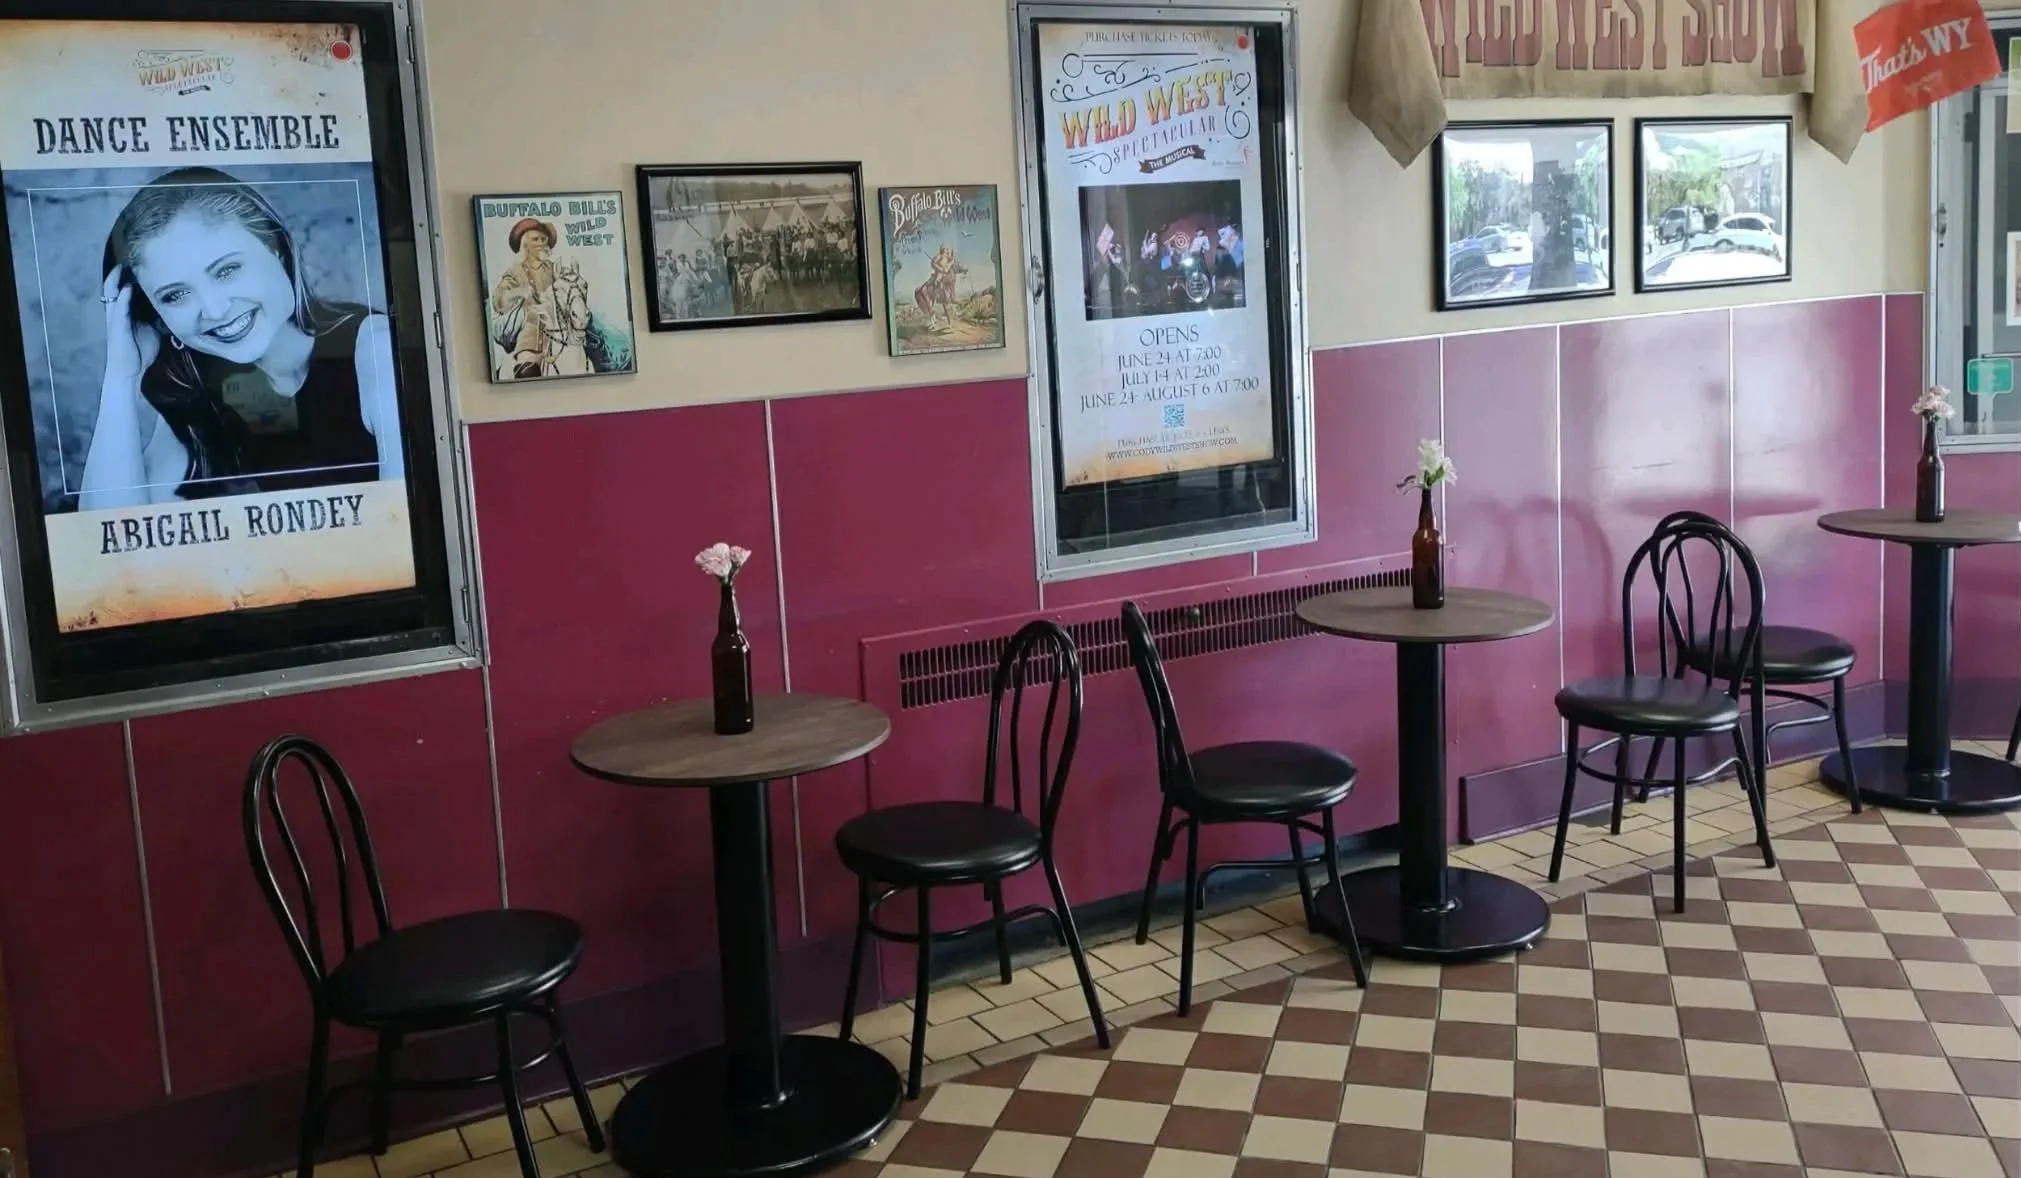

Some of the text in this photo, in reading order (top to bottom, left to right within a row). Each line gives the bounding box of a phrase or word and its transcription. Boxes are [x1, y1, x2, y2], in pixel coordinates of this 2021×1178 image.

[1085, 31, 1137, 43] PURCHASE
[1139, 31, 1178, 43] TICKETS
[1860, 37, 1927, 94] That's
[1920, 17, 1973, 56] WY
[140, 66, 177, 86] WILD
[181, 56, 224, 78] WEST
[1059, 70, 1233, 149] WILD WEST
[33, 113, 341, 155] DANCE ENSEMBLE
[1113, 115, 1217, 164] SPECTACULAR
[1149, 160, 1163, 170] THE
[1164, 147, 1196, 164] MUSICAL
[483, 199, 617, 218] BUFFALO BILL'S
[888, 192, 932, 239] Buffalo
[932, 189, 961, 210] Bill's
[565, 217, 608, 235] WILD
[566, 233, 615, 247] WEST
[1139, 324, 1200, 347] OPENS
[1117, 346, 1222, 372] JUNE 24 AT 7:00
[1121, 371, 1150, 389] JULY
[1175, 367, 1191, 381] AT
[1194, 363, 1220, 379] 2:00
[1080, 392, 1117, 413] JUNE
[1143, 383, 1199, 401] AUGUST
[1201, 382, 1210, 395] 6
[1214, 379, 1232, 393] AT
[1234, 376, 1260, 391] 7:00
[100, 494, 365, 555] ABIGAIL RONDEY
